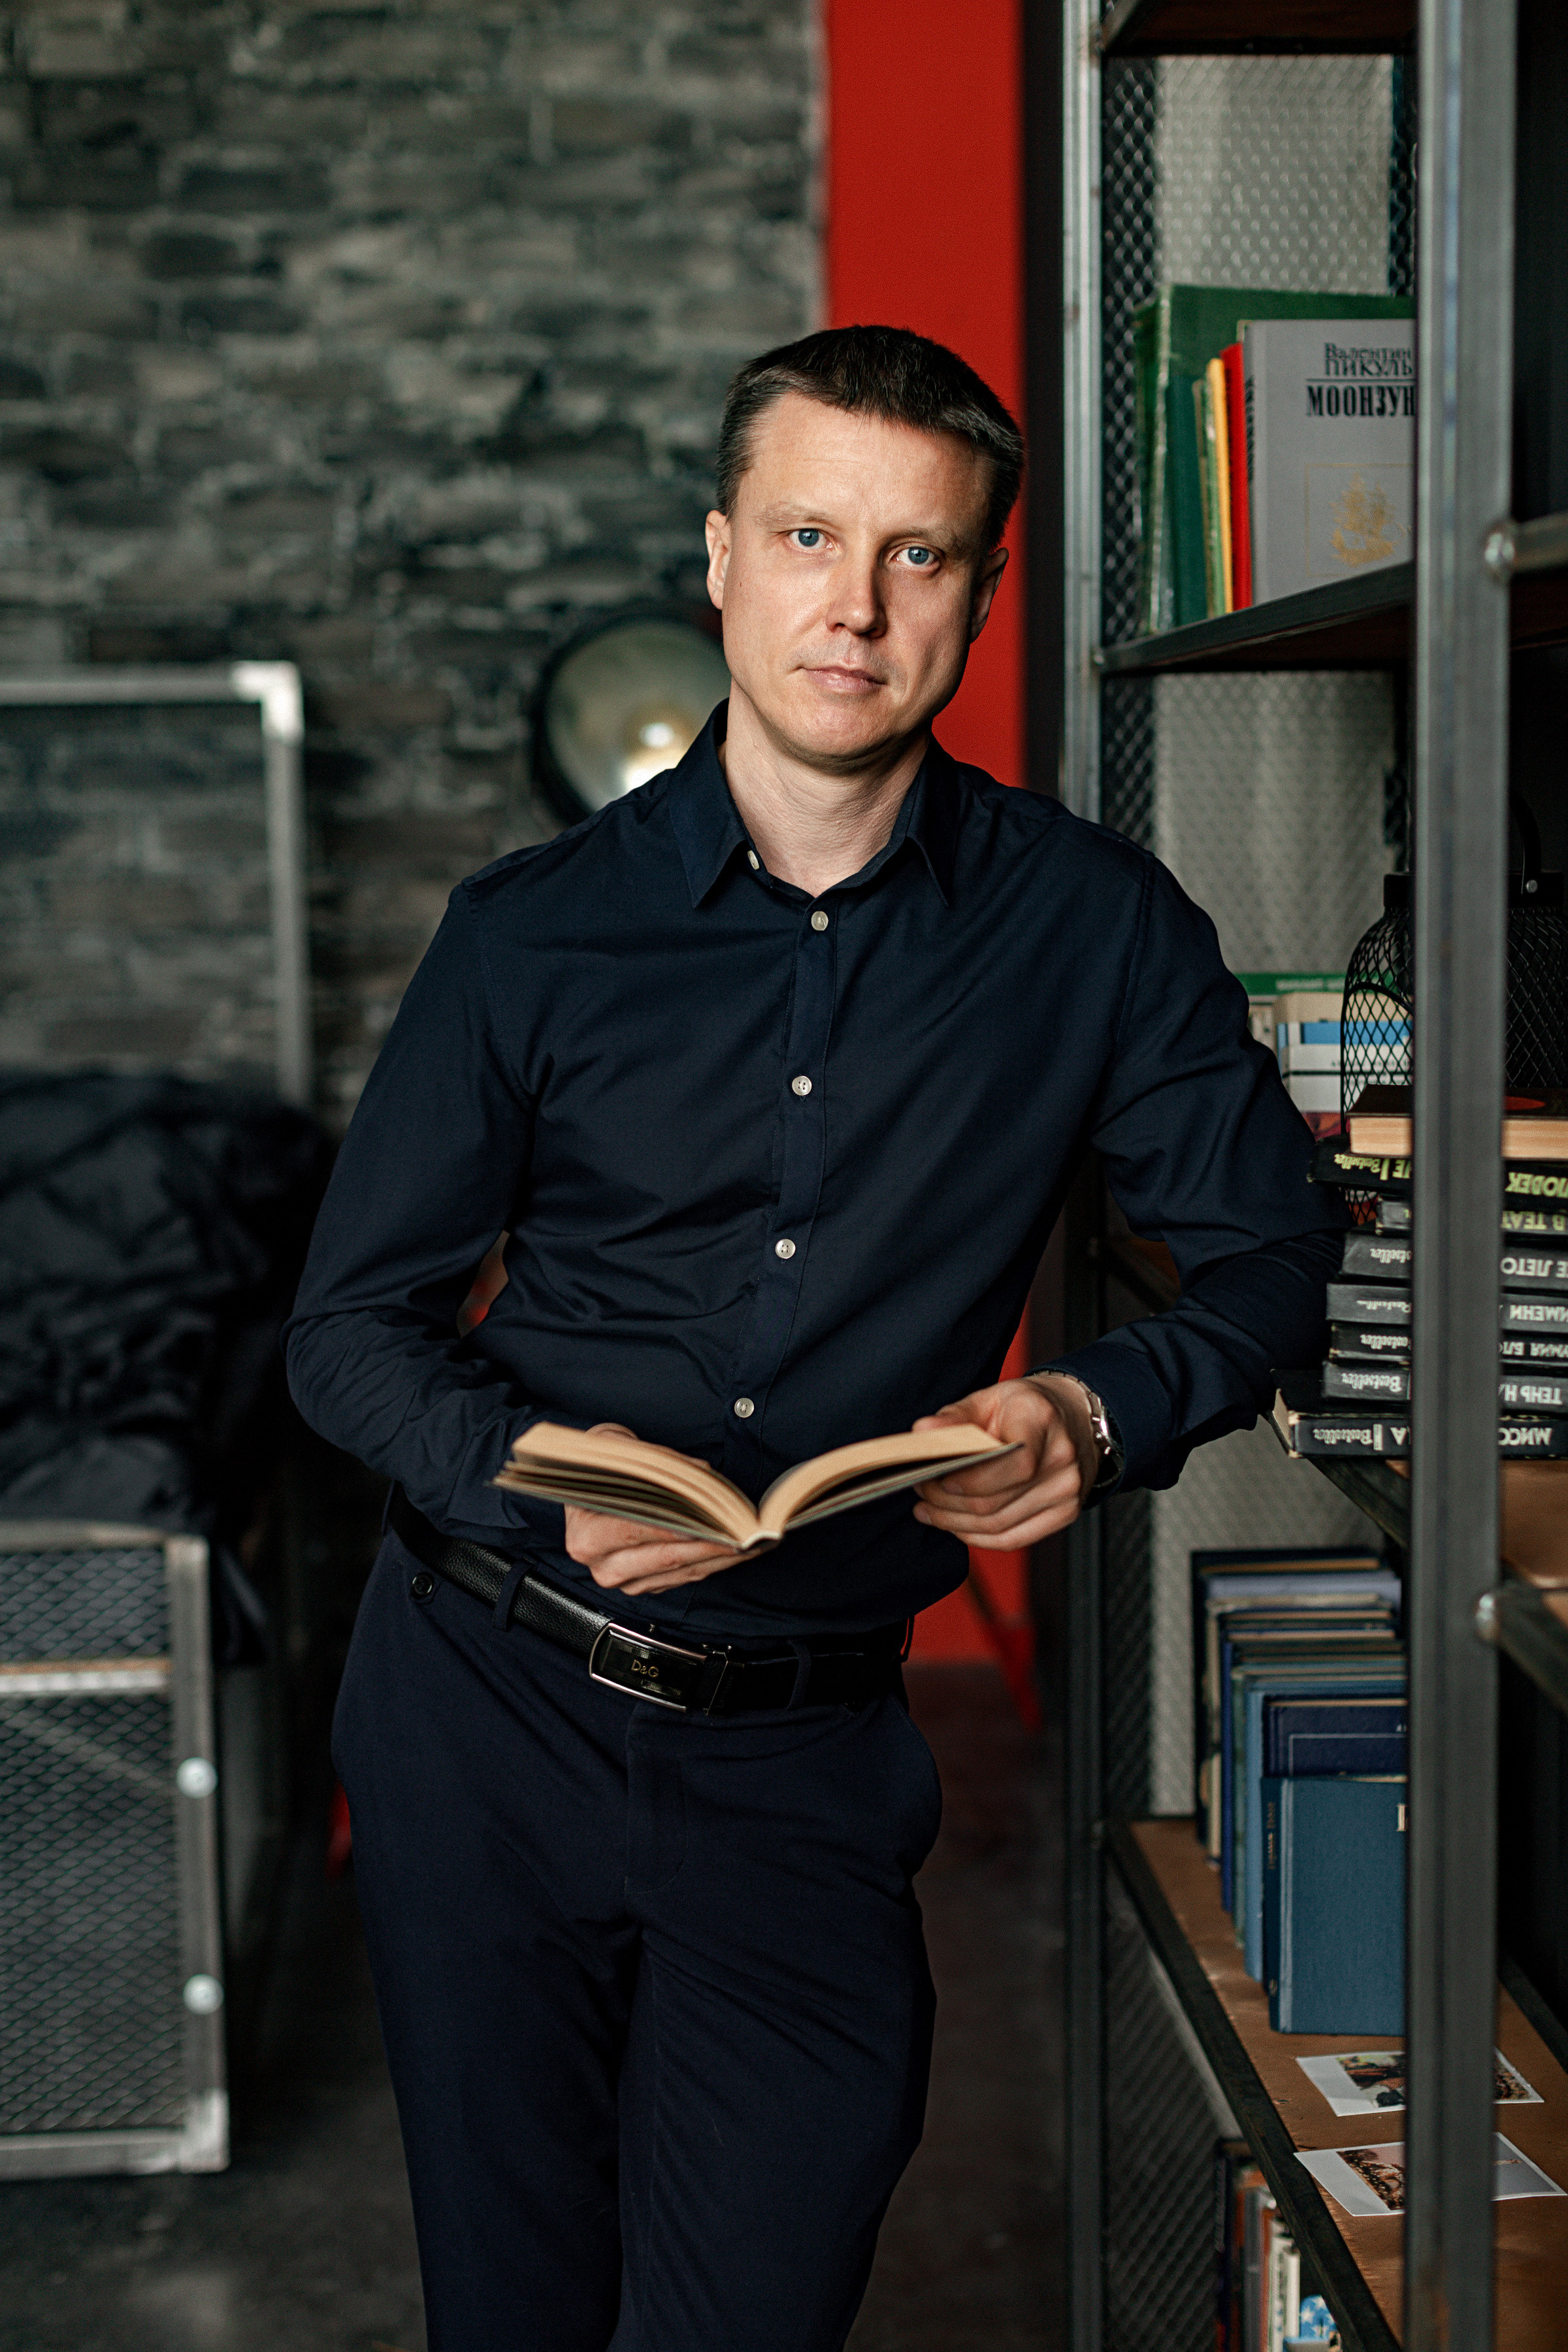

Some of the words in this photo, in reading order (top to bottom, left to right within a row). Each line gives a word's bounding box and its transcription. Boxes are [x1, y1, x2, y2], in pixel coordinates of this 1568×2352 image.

[1324, 342, 1411, 359] Валентин
[1307, 385, 1416, 416] МООНЗУН
[1333, 1153, 1381, 1173] Bestseller
[1500, 1257, 1554, 1277] ЛЕТО
[1360, 1333, 1411, 1350] estseller
[1499, 1341, 1525, 1356] БЛ
[1341, 1373, 1403, 1393] Bestseller
[1520, 1385, 1563, 1405] ТЕНЬ
[1313, 1428, 1373, 1445] Bestseller
[630, 1659, 659, 1678] D&G
